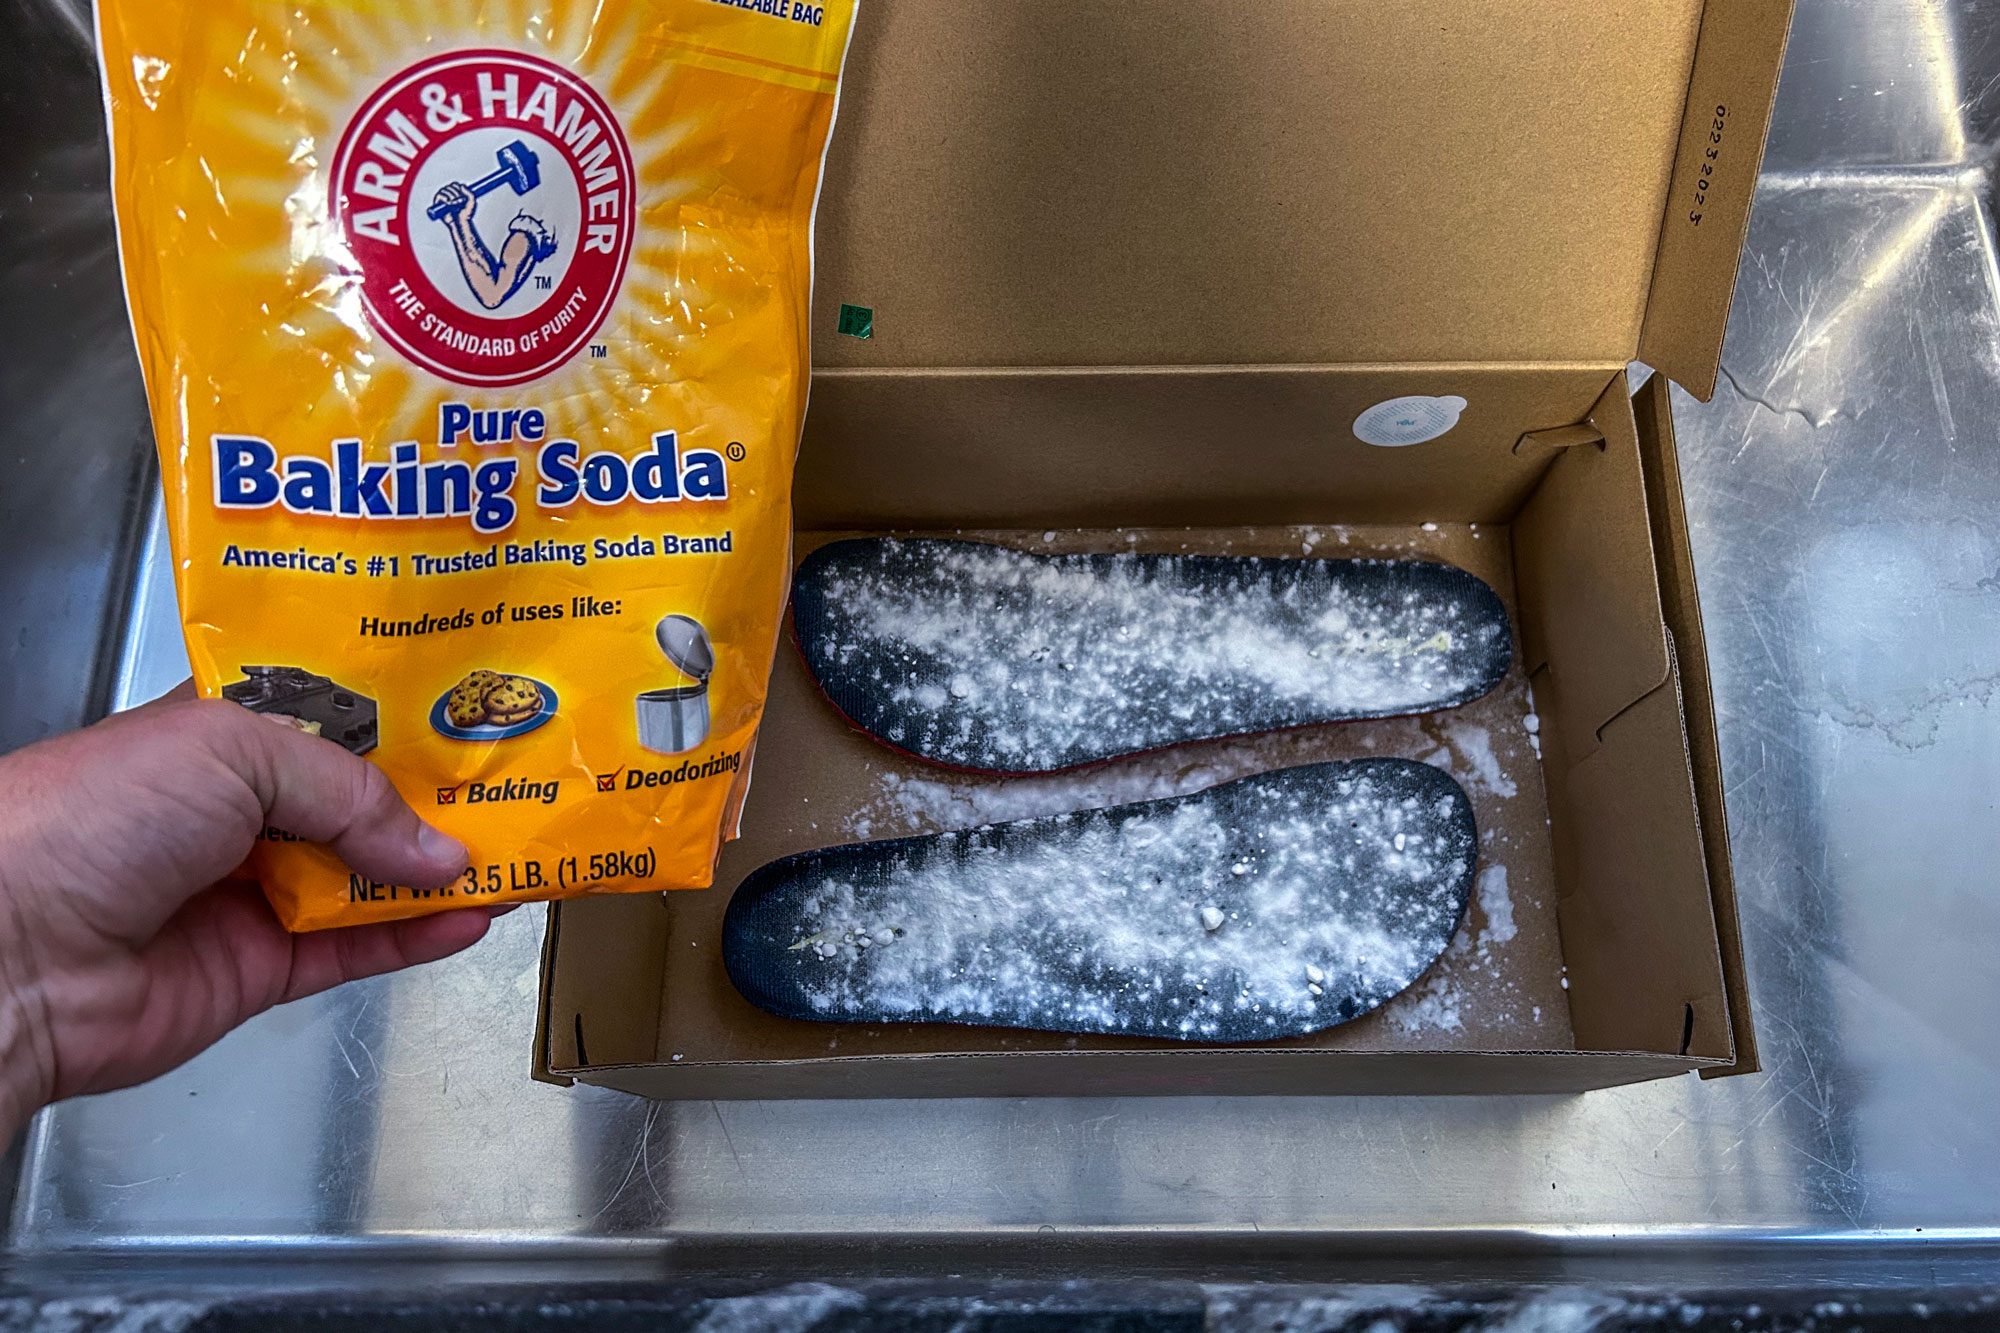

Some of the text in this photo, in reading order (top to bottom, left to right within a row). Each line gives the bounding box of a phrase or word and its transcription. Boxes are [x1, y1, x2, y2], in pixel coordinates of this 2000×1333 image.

[791, 2, 823, 26] BAG
[352, 71, 622, 256] ARM & HAMMER
[535, 276, 552, 289] TM
[389, 278, 588, 357] THE STANDARD OF PURITY
[590, 345, 607, 358] TM
[441, 402, 545, 446] Pure
[213, 434, 518, 532] Baking
[537, 431, 728, 507] Soda
[222, 531, 732, 577] America's #1 Trusted Baking Soda Brand
[359, 595, 622, 637] Hundreds of uses like:
[466, 777, 560, 804] Baking
[625, 750, 741, 790] Deodorizing
[462, 864, 502, 895] 3.5
[509, 861, 550, 891] LB.
[557, 846, 657, 889] (1.58kg)
